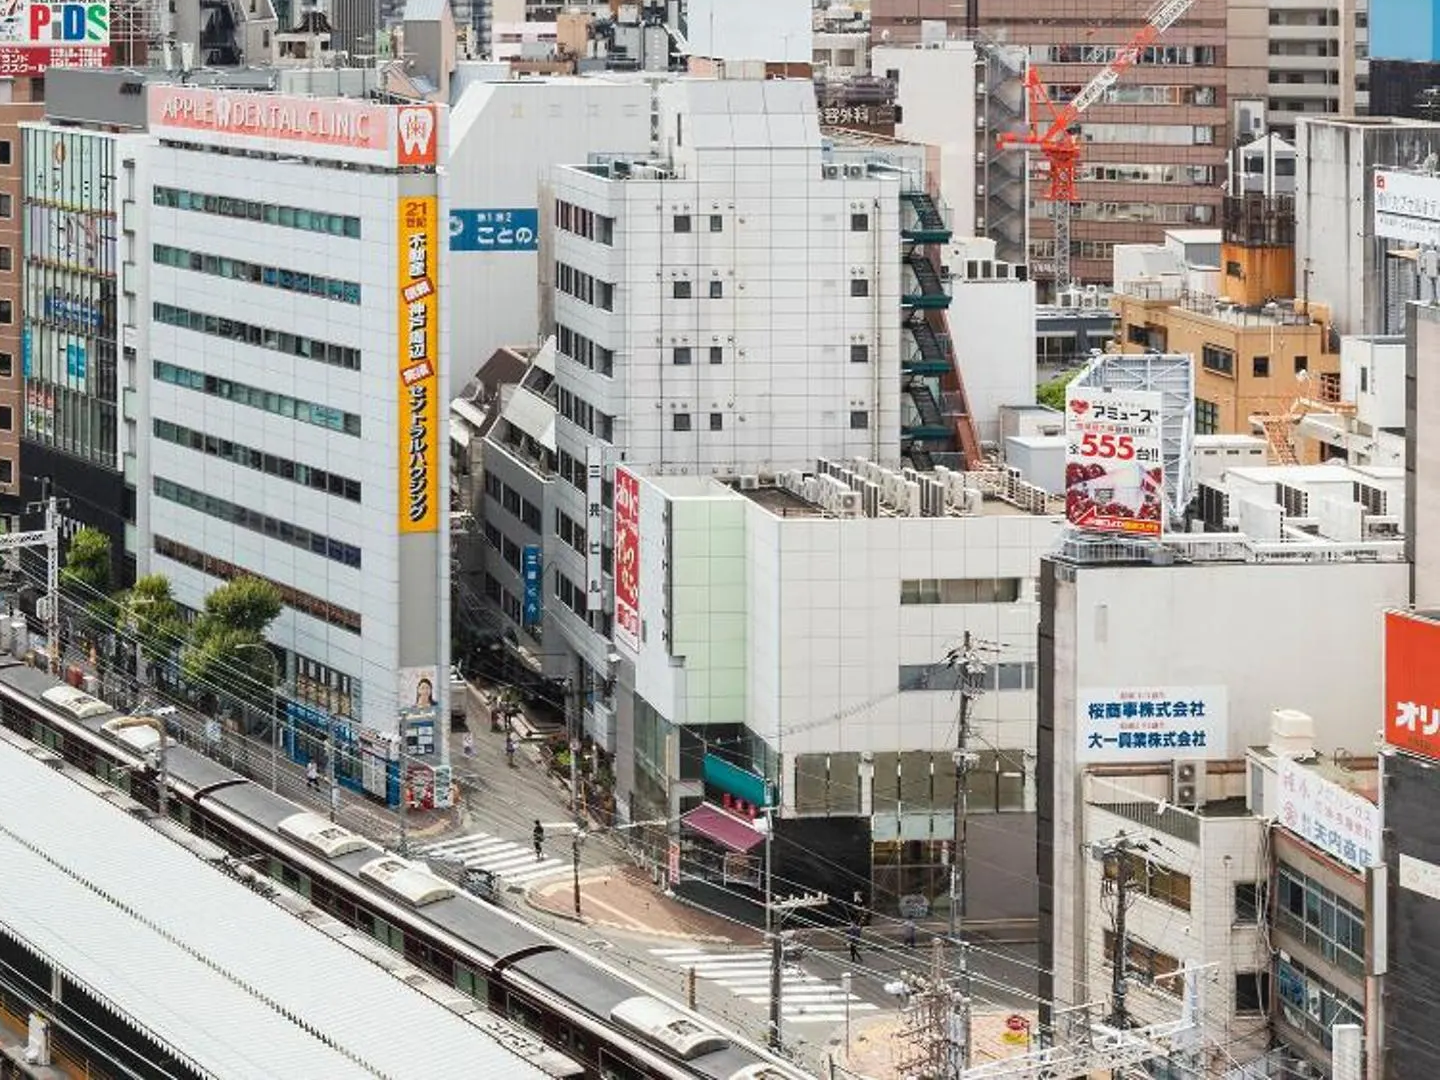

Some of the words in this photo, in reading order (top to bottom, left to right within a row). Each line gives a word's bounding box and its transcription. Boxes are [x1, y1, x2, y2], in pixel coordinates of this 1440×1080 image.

[162, 96, 212, 123] APPLE
[235, 102, 302, 134] DENTAL
[307, 111, 370, 141] CLINIC
[406, 202, 428, 217] 21
[477, 226, 539, 245] ことの
[1092, 405, 1158, 423] アミューズ
[409, 385, 428, 522] セントラルハウジング
[589, 465, 600, 593] 三共ビル
[1088, 700, 1206, 719] 桜商事株式会社
